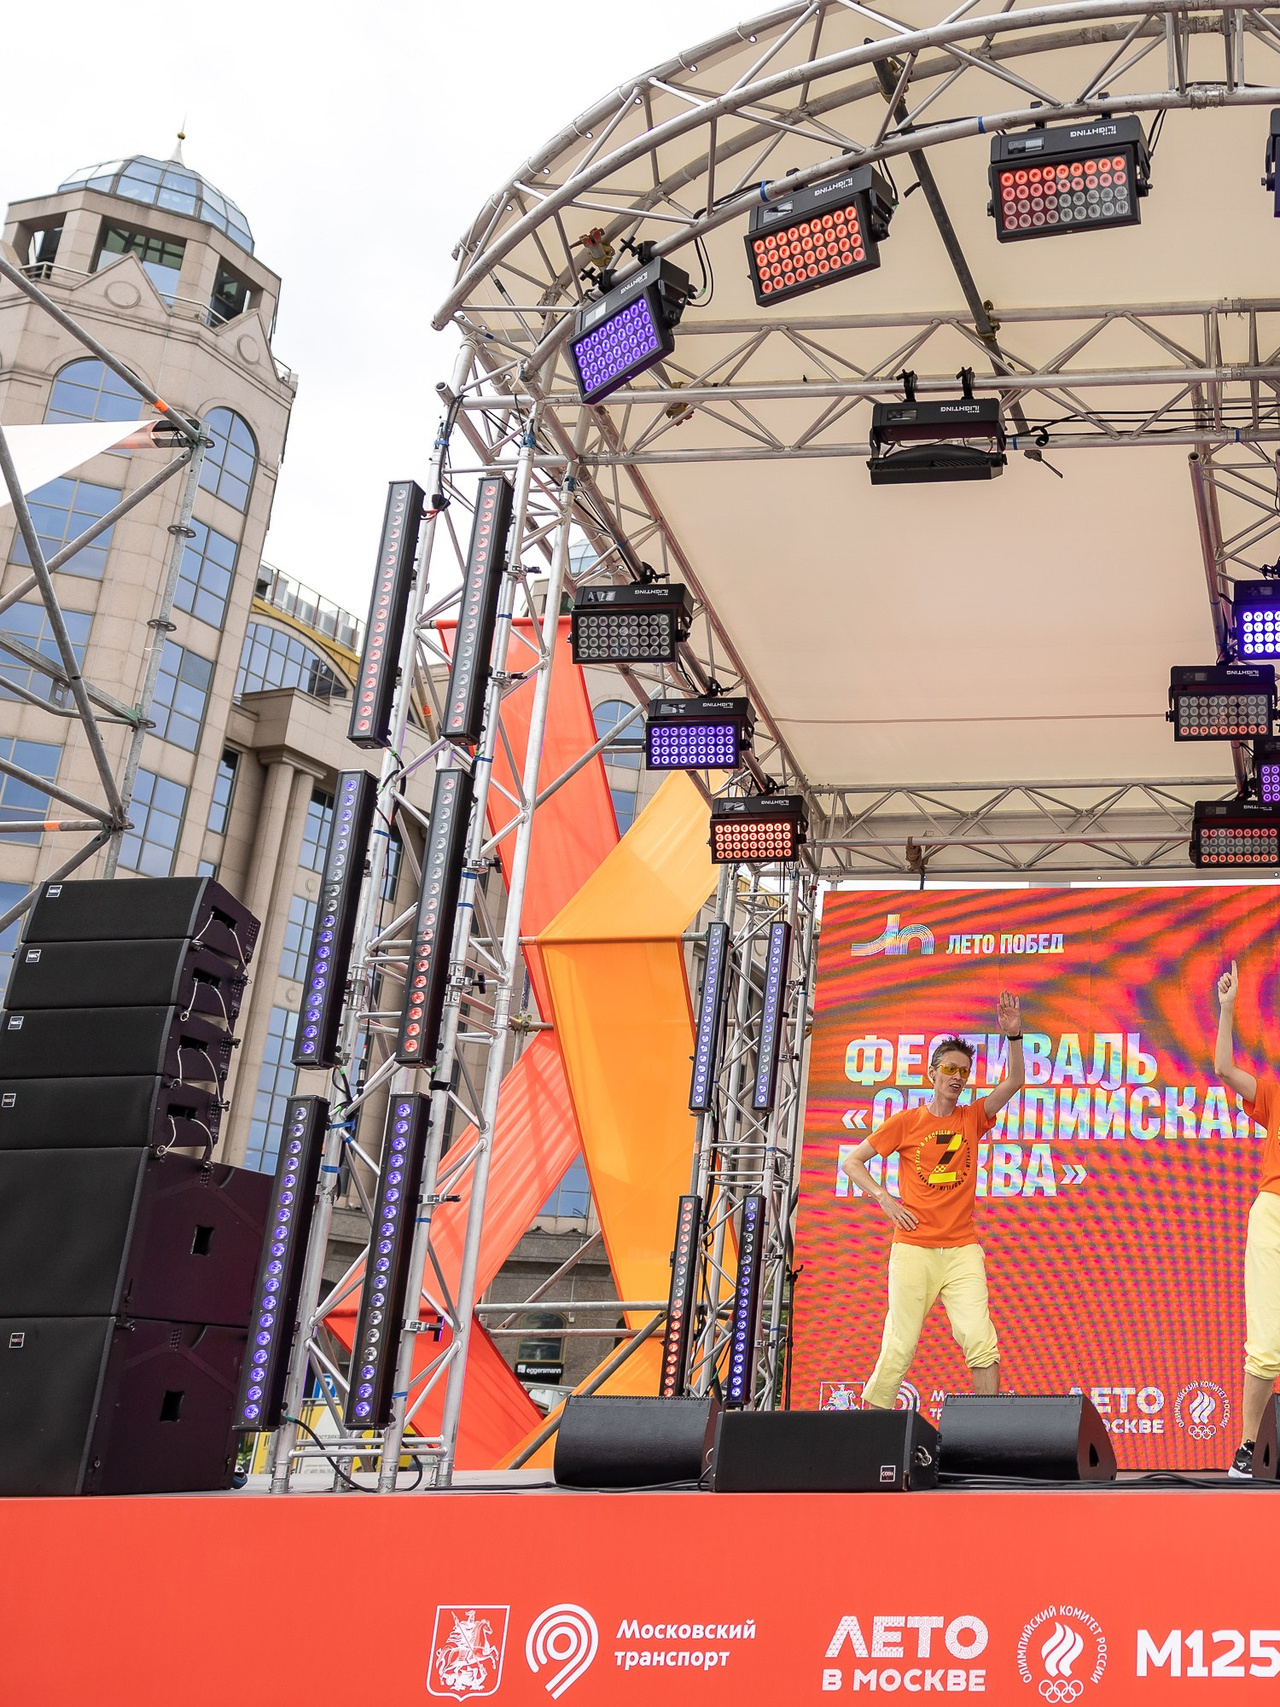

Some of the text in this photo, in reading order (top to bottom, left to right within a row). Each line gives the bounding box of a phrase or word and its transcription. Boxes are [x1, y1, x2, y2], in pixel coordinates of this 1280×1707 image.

[946, 933, 1065, 955] ЛЕТО ПОБЕД
[835, 1144, 1088, 1198] МВА»
[526, 1367, 562, 1375] eggersmann
[1200, 1380, 1228, 1400] КОМИТЕТ
[1219, 1399, 1231, 1429] РОССИИ
[616, 1618, 756, 1640] Московский
[824, 1615, 989, 1659] ЛЕТО
[1017, 1605, 1107, 1684] ОЛИМПИЙСКИЙ КОМИТЕТ РОССИИ
[614, 1650, 731, 1672] транспорт
[822, 1669, 987, 1692] В МОСКВЕ
